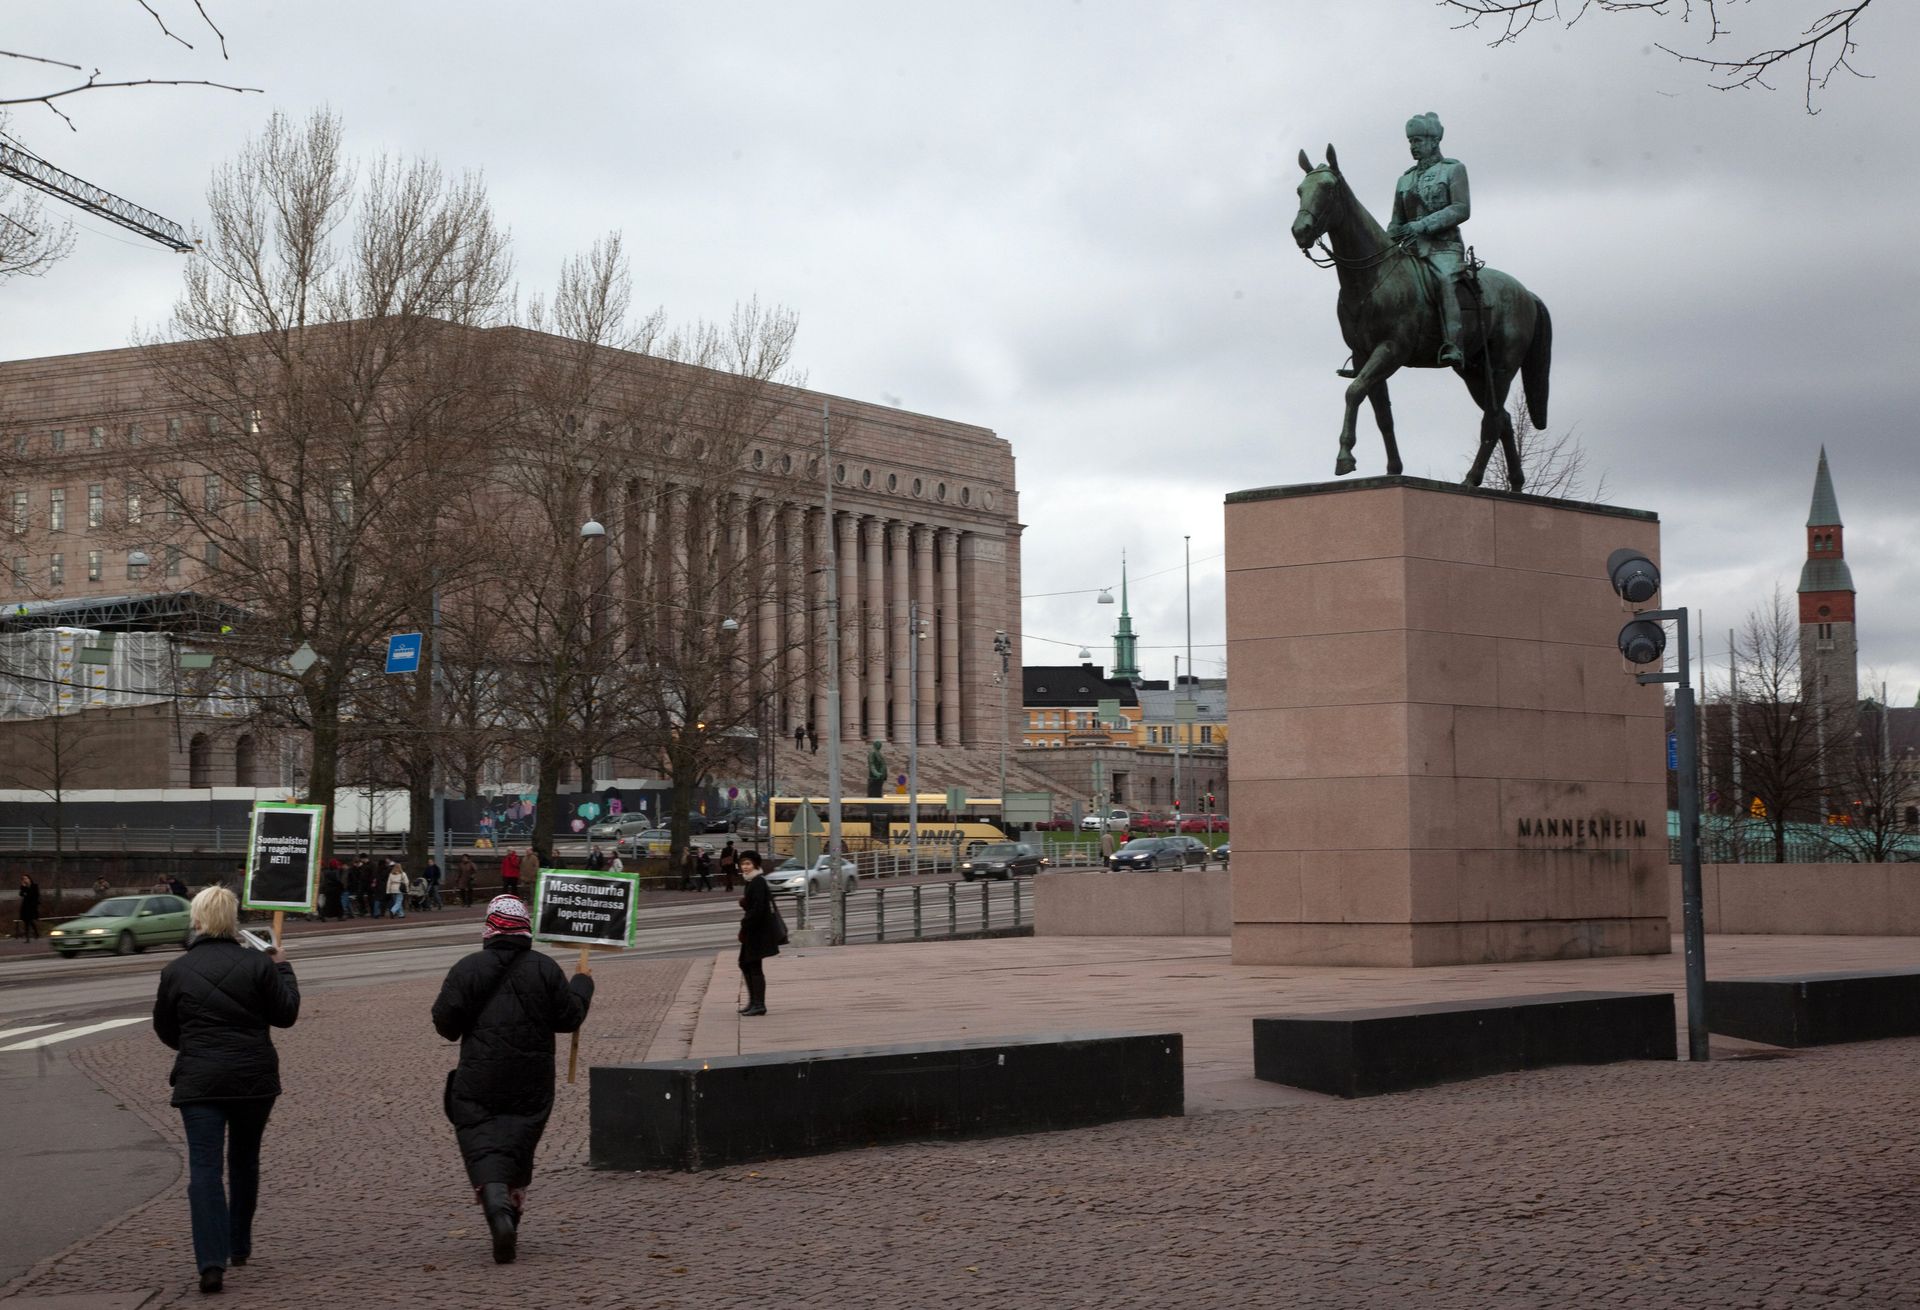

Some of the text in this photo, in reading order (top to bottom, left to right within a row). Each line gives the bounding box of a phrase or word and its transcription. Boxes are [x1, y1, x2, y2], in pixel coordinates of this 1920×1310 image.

[1518, 817, 1647, 839] MANNERHEIM
[257, 836, 308, 845] Suomalaisten
[268, 845, 306, 854] reagoitava
[270, 856, 290, 864] HETI!
[550, 880, 624, 896] Massamurha
[547, 894, 624, 909] Länsi-Saharassa
[557, 908, 611, 922] lopetettava
[572, 922, 593, 932] NYT!
